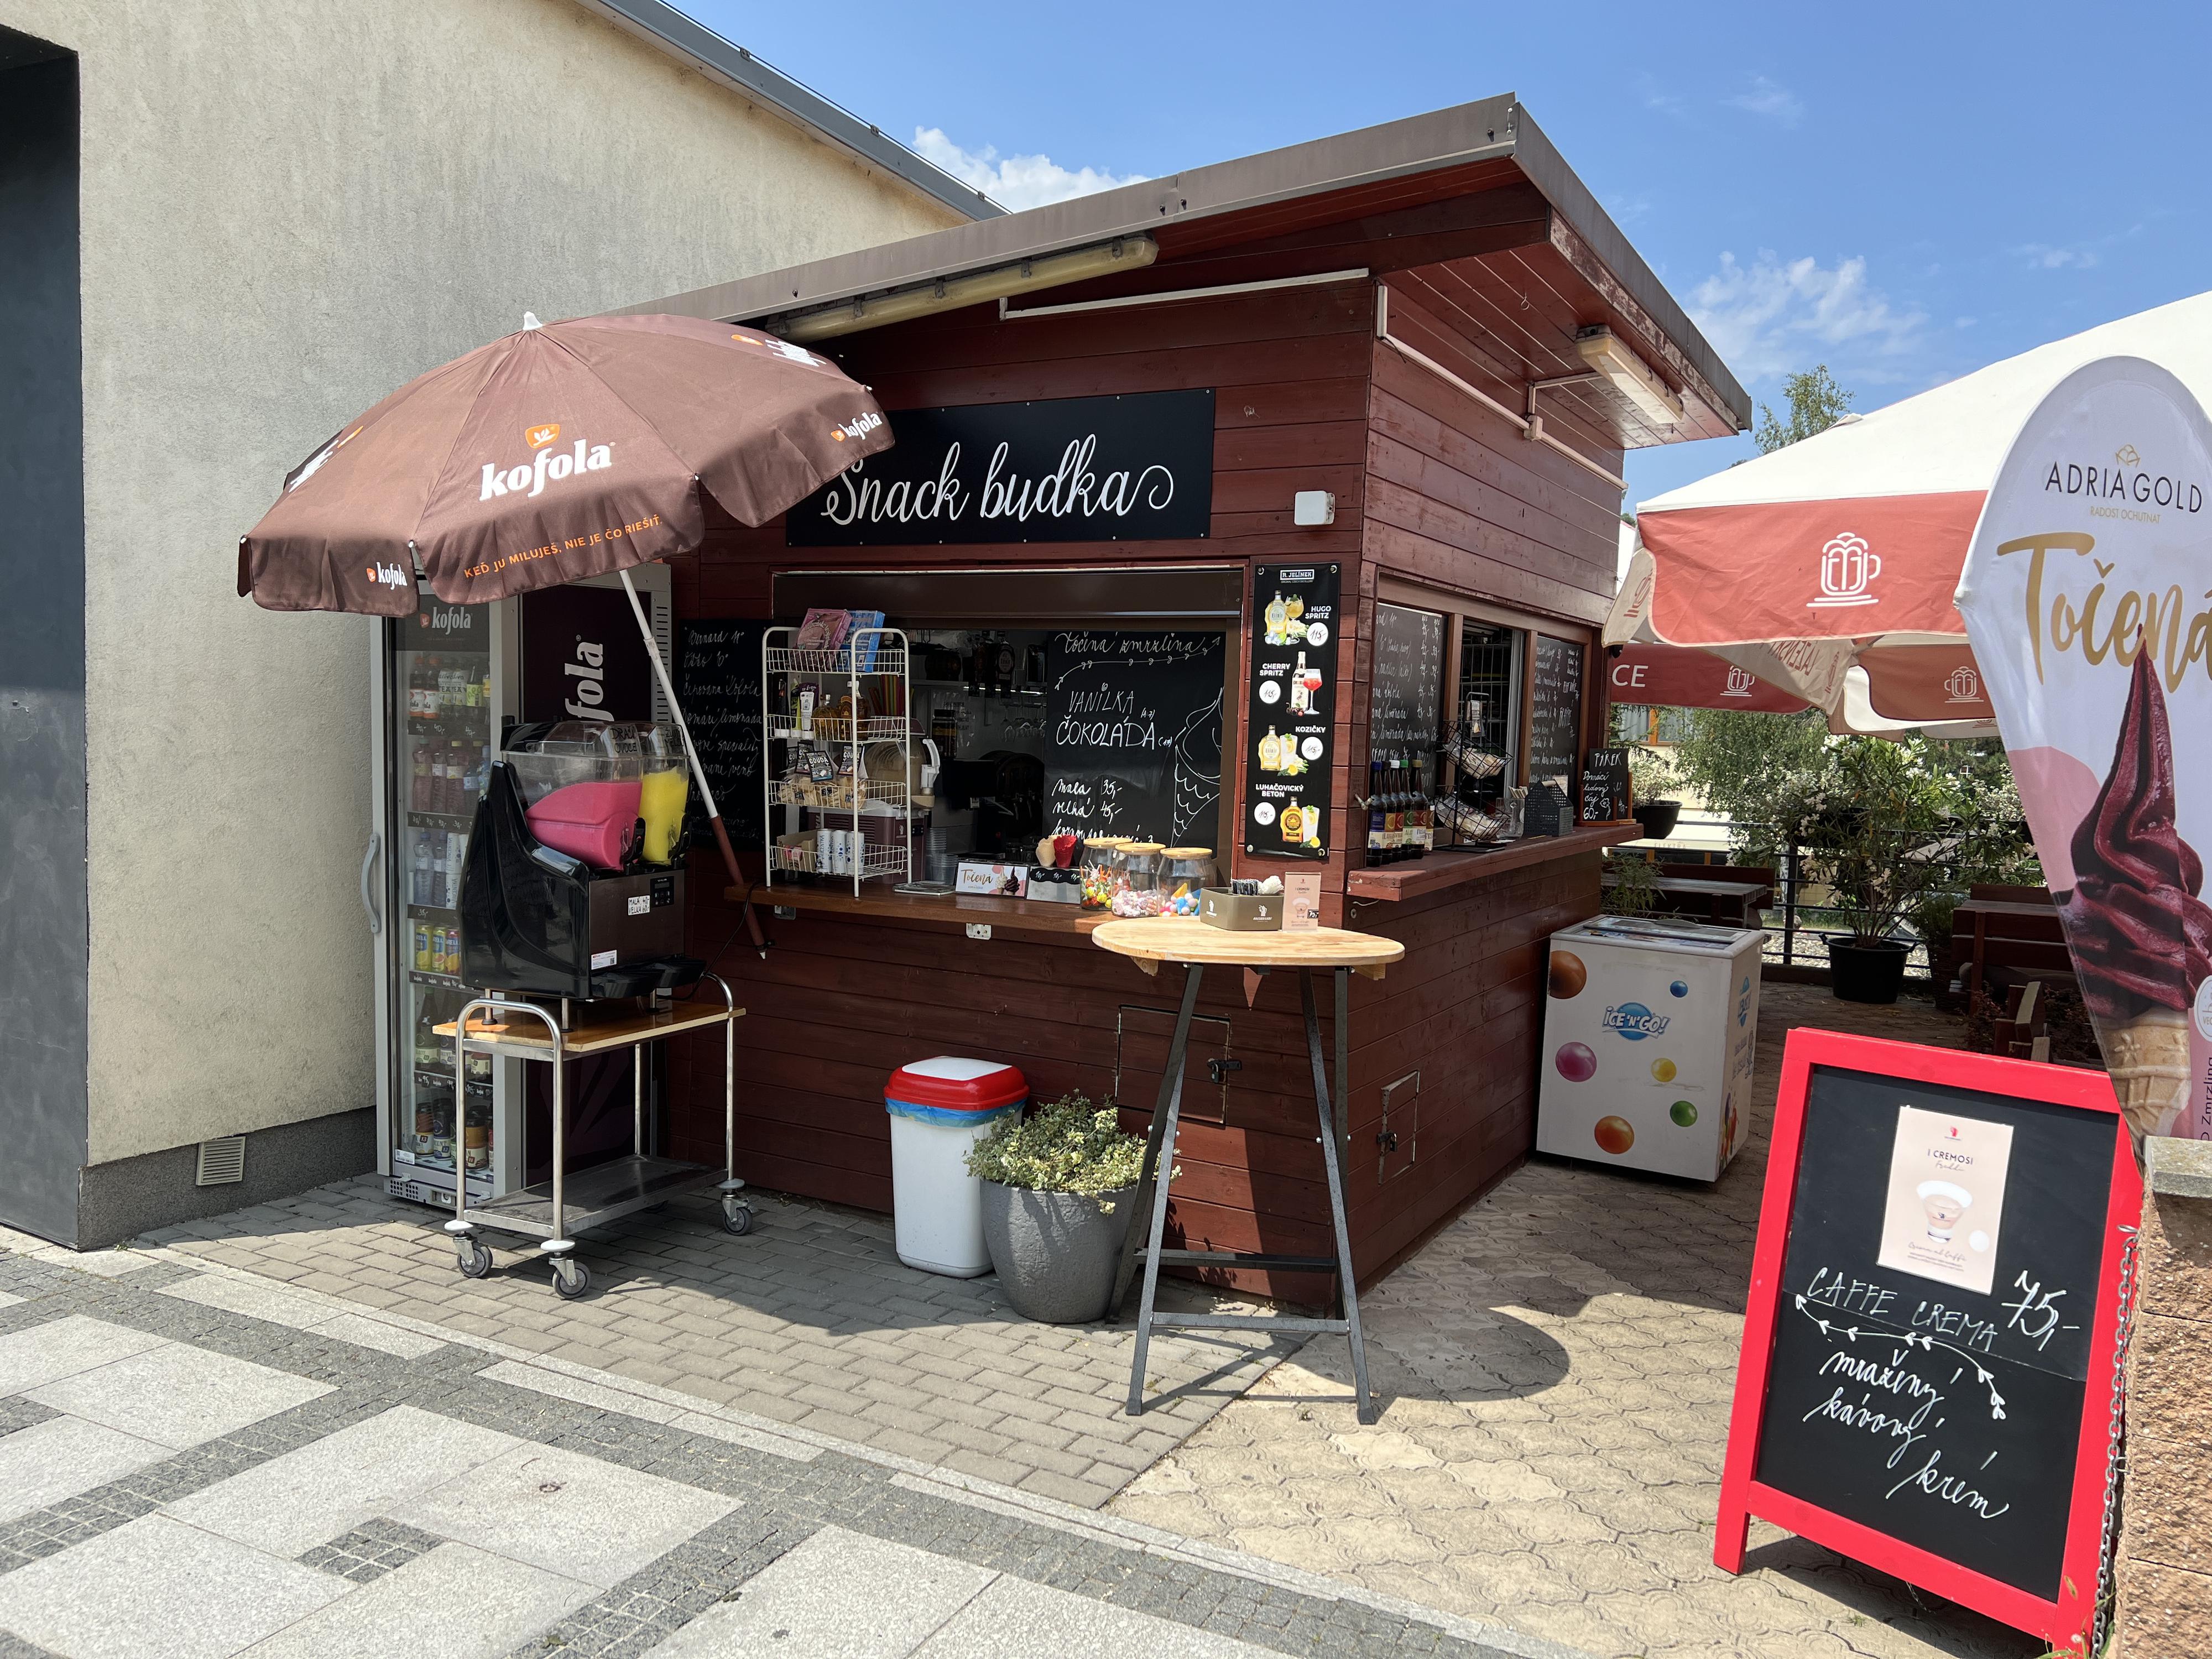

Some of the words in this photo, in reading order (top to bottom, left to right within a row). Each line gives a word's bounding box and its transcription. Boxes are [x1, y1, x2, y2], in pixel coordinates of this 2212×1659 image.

[838, 412, 883, 440] kofola
[479, 439, 612, 501] kofola
[821, 441, 969, 526] Snack
[980, 434, 1173, 521] budka
[2046, 461, 2126, 499] ADRIA
[2133, 473, 2202, 513] GOLD
[2090, 506, 2119, 518] RADOST
[2121, 510, 2161, 523] OCHUTNAT
[464, 562, 489, 579] KEĎ
[493, 559, 505, 572] JU
[509, 542, 562, 565] MILUJEŠ,
[565, 537, 586, 550] NIE
[589, 533, 602, 546] JE
[605, 528, 622, 540] ČO
[377, 562, 407, 591] kofola
[432, 607, 471, 635] kofola
[564, 641, 614, 722] fola
[1056, 714, 1155, 750] ČOKOLÁDA
[1295, 725, 1326, 733] KOZIČKY
[1595, 750, 1621, 767] PÁREK
[1255, 783, 1304, 792] LUHAČOVICKÝ
[1583, 771, 1609, 781] Domácí
[1100, 801, 1123, 825] 45,-
[1584, 792, 1599, 807] čaj
[961, 869, 993, 885] Točená
[1933, 1150, 1974, 1165] CREMOSI
[1911, 1300, 1998, 1353] CREMA
[2001, 1270, 2080, 1352] 75,-
[1803, 1386, 1945, 1469] kávový
[1886, 1450, 2010, 1519] krém
